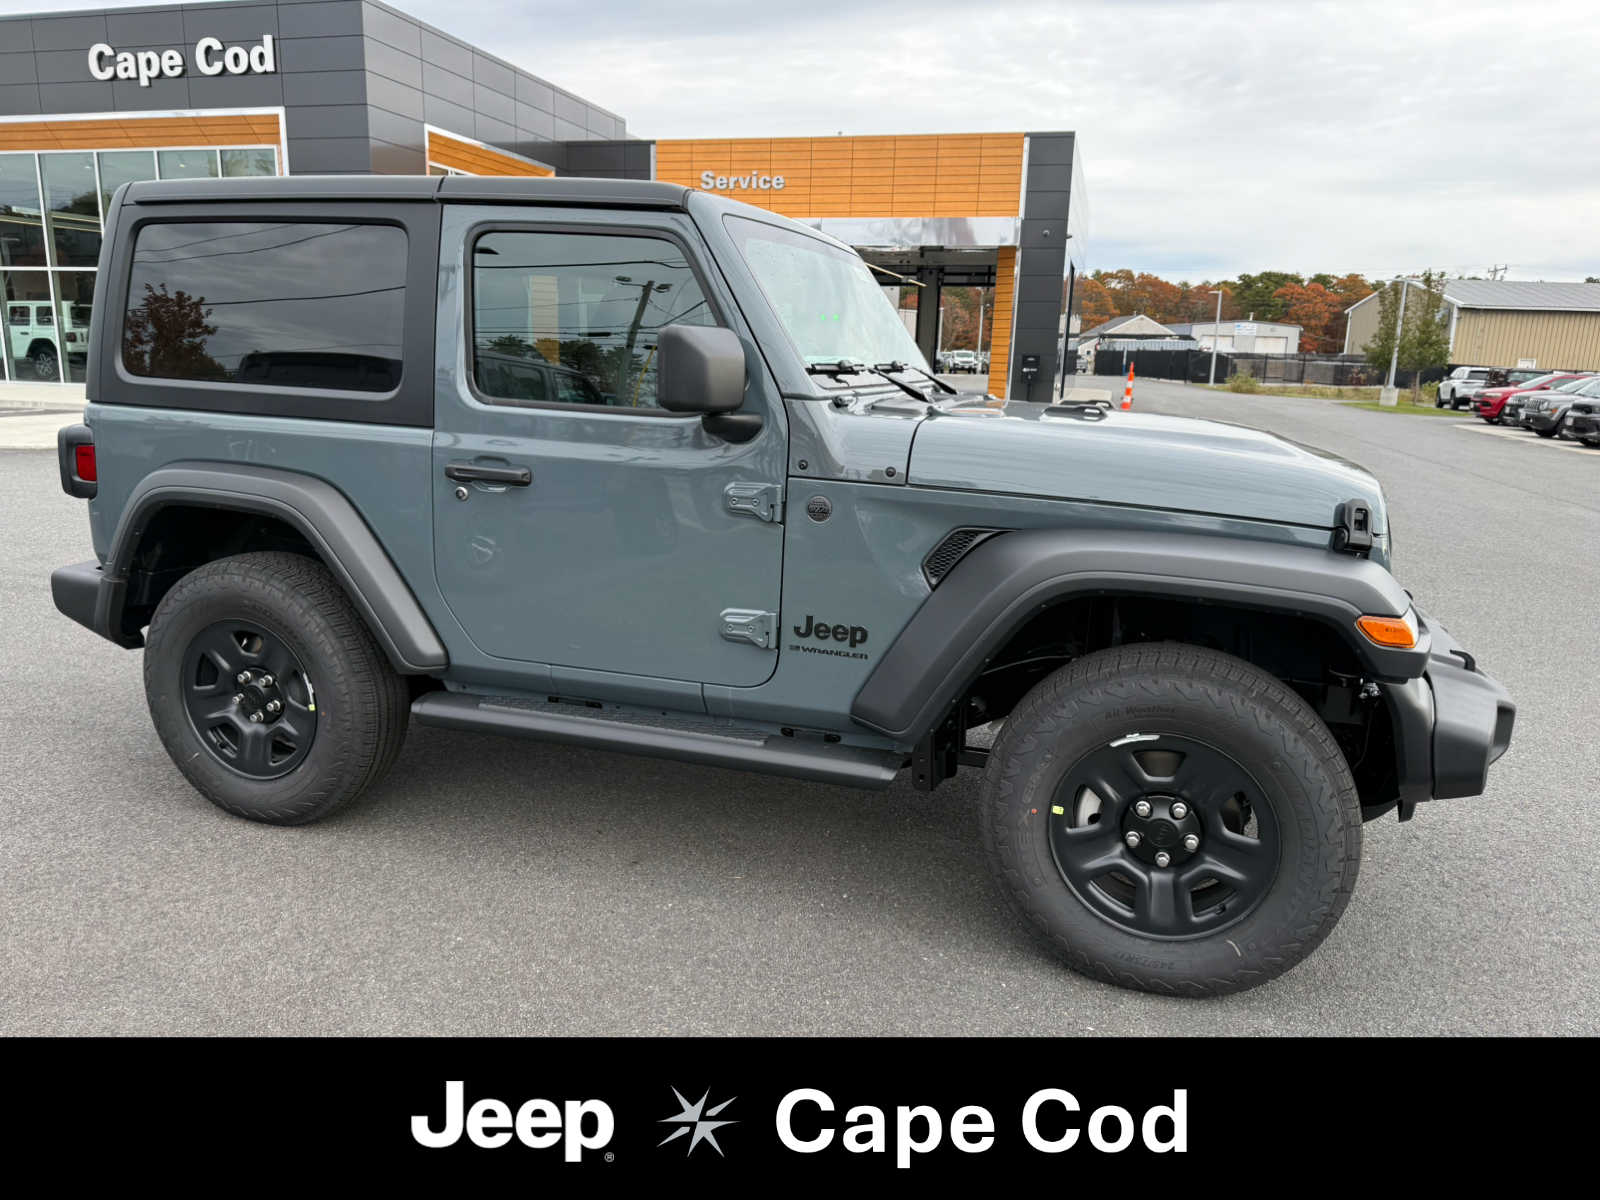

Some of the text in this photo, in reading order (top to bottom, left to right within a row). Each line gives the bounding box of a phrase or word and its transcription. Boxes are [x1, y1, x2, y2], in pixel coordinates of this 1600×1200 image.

[87, 34, 276, 88] Cape Cod
[700, 169, 786, 191] Service
[793, 614, 869, 648] Jeep
